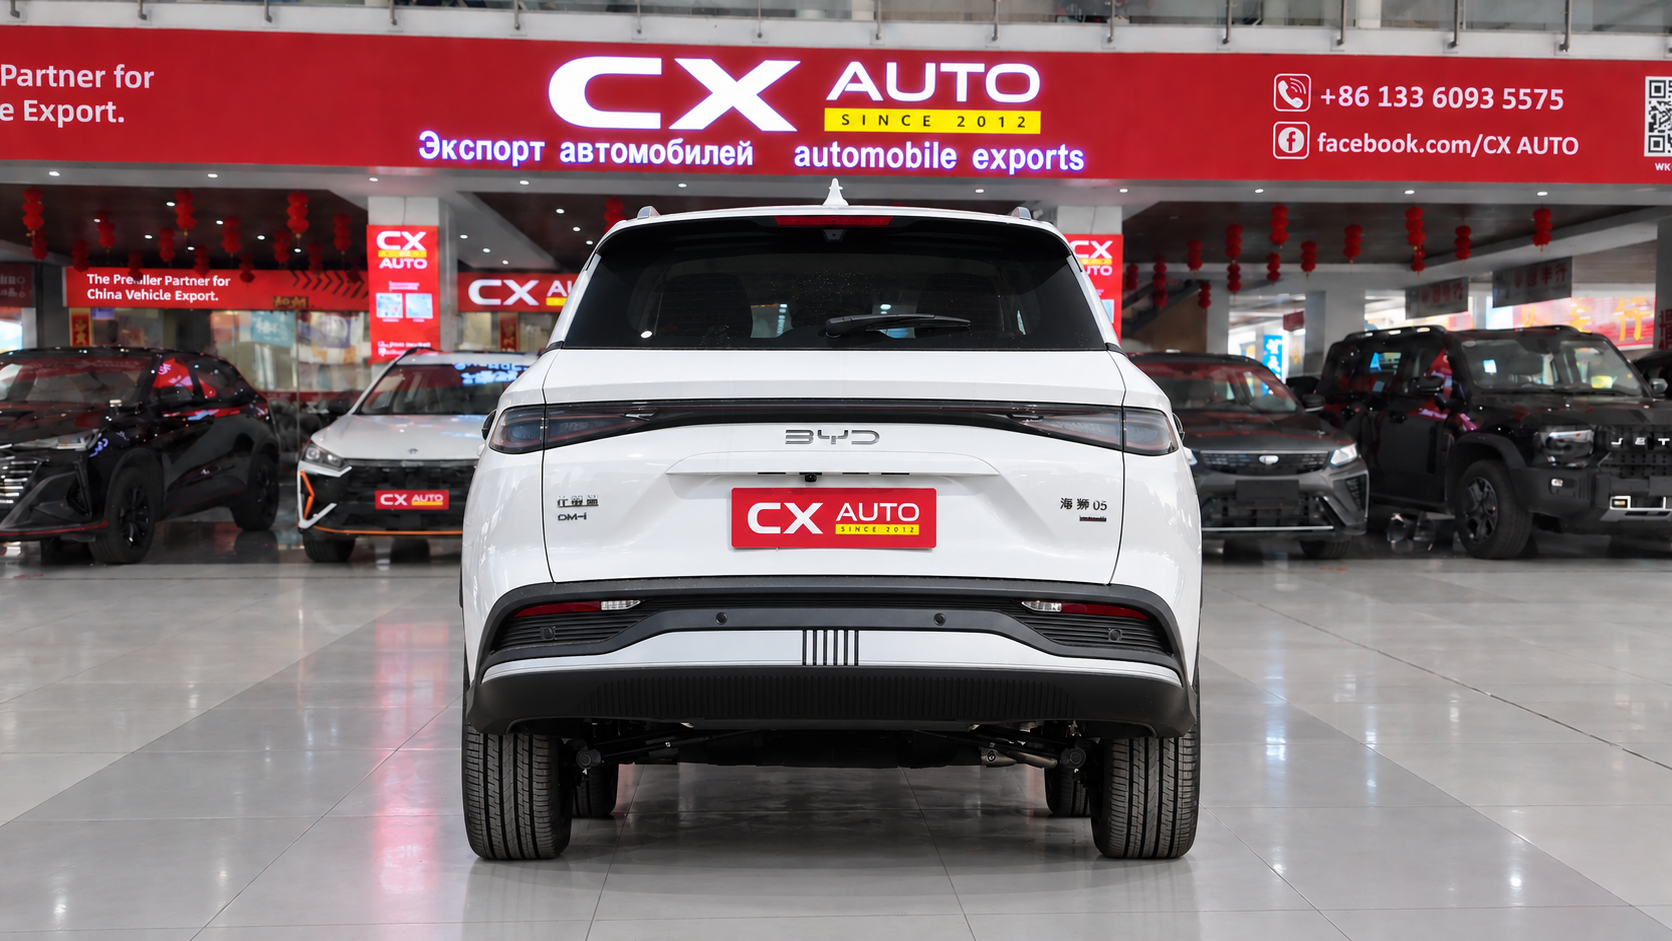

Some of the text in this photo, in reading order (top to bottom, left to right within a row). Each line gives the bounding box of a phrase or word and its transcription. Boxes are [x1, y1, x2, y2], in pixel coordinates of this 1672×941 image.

[1, 64, 154, 88] Partner for
[549, 56, 1040, 131] CX AUTO
[1321, 86, 1564, 110] +86 133 6093 5575
[24, 100, 125, 129] Export.
[842, 114, 1026, 128] SINCE 2012
[418, 131, 754, 167] Экспорт автомобилей
[1318, 132, 1579, 158] facebook.com/CX AUTO
[795, 140, 1085, 176] automobile exports
[1655, 162, 1672, 172] WK
[376, 231, 427, 251] CX
[1070, 240, 1113, 259] CX
[379, 258, 428, 269] AUTO
[1085, 265, 1113, 276] UTO
[87, 274, 110, 285] The
[165, 276, 210, 286] Partner
[213, 275, 230, 286] for
[87, 288, 219, 303] China Vehicle Export.
[467, 279, 540, 306] CX
[785, 429, 880, 445] BYD
[380, 494, 443, 506] CX AUTO
[747, 502, 920, 534] CX AUTO
